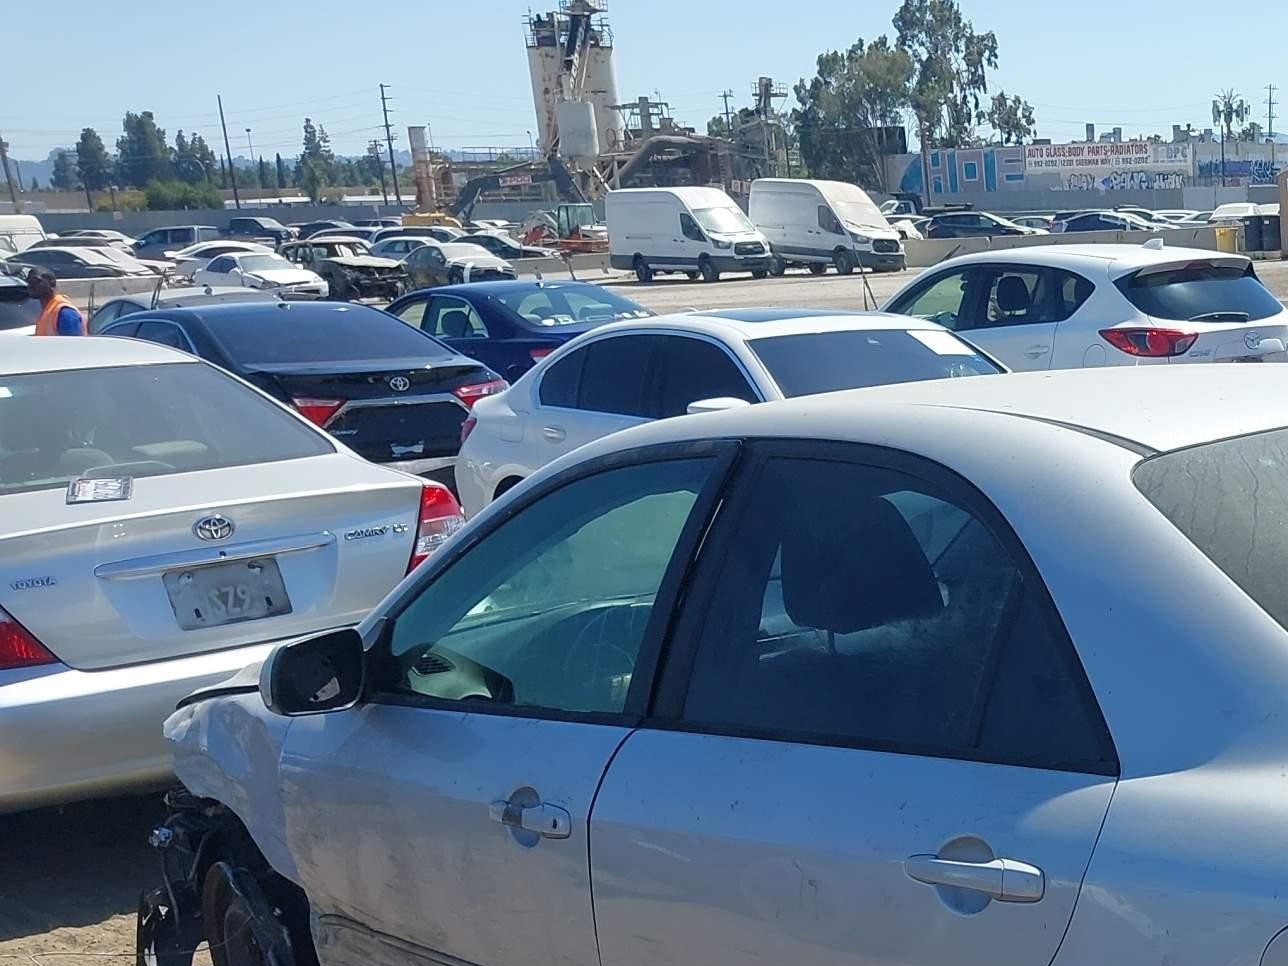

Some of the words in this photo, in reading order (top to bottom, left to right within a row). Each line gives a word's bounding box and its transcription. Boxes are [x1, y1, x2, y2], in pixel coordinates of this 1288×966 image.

[1027, 147, 1044, 158] AUTO
[344, 525, 390, 541] CAMRY
[9, 576, 58, 592] TOYOTA
